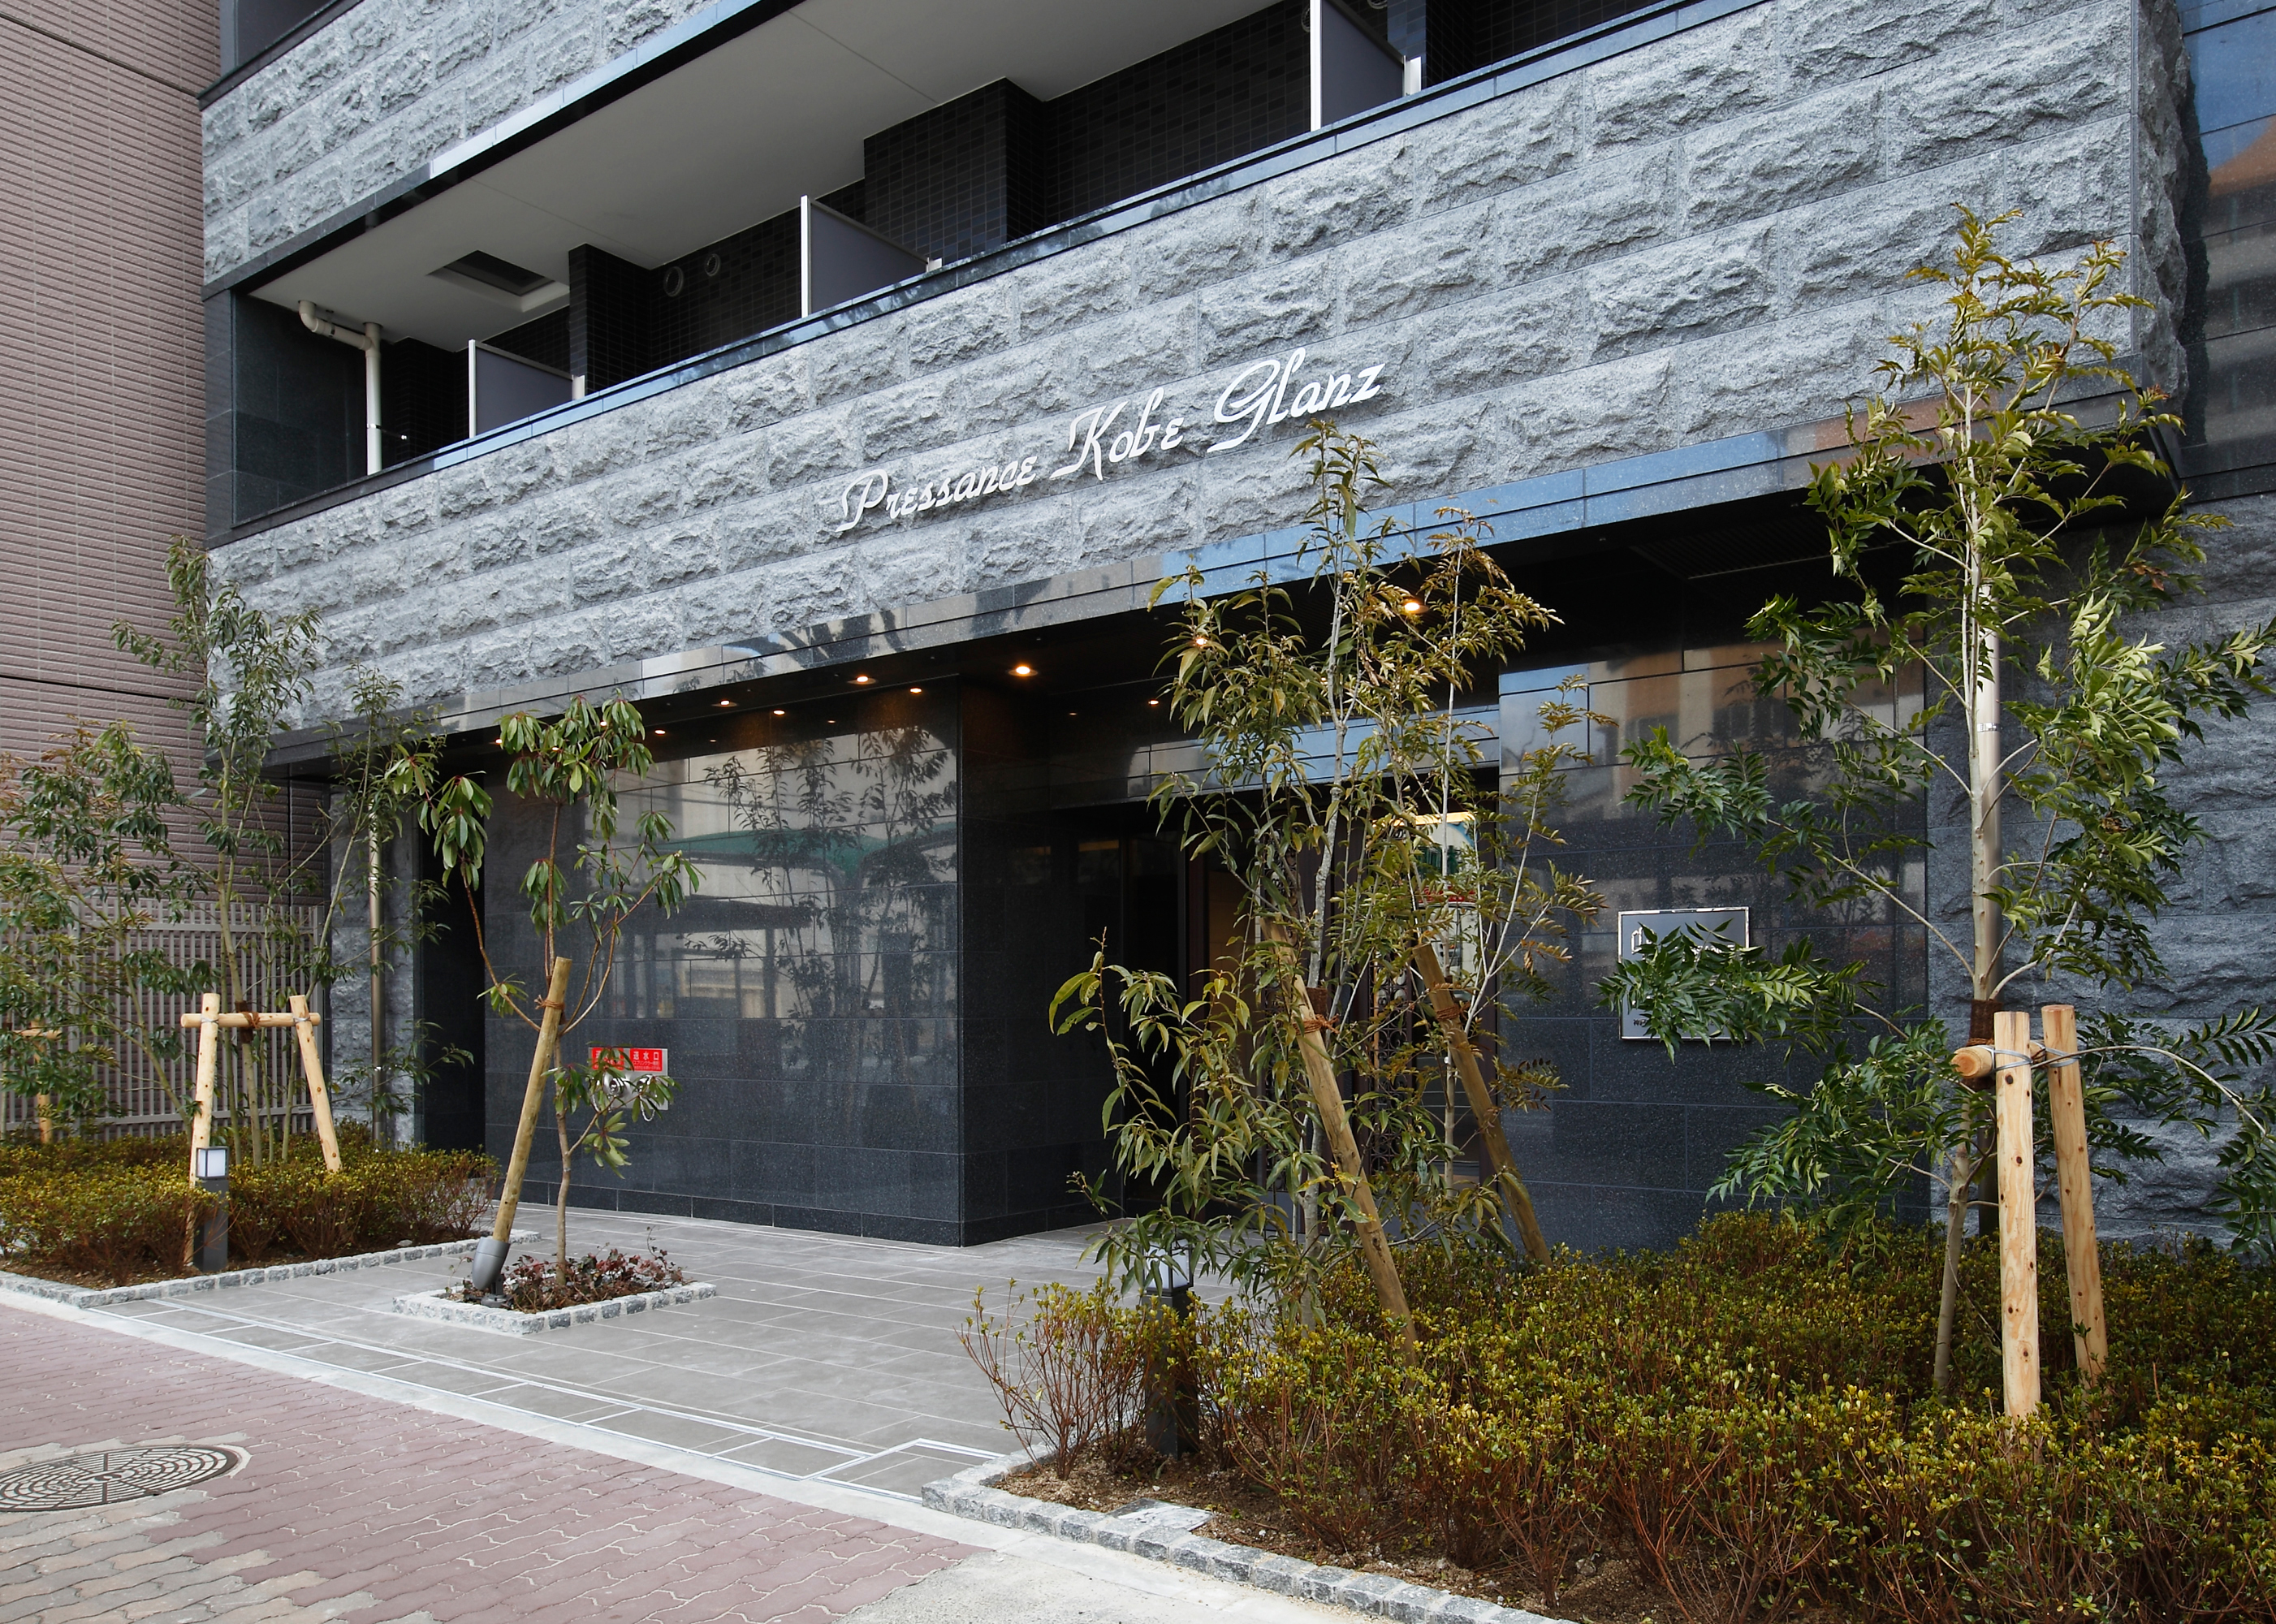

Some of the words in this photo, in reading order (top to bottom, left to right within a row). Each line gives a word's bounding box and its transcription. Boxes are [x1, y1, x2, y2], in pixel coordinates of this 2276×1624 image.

[835, 456, 1036, 532] Pressance
[1050, 387, 1184, 480] Kobe
[1207, 347, 1385, 452] Glanz
